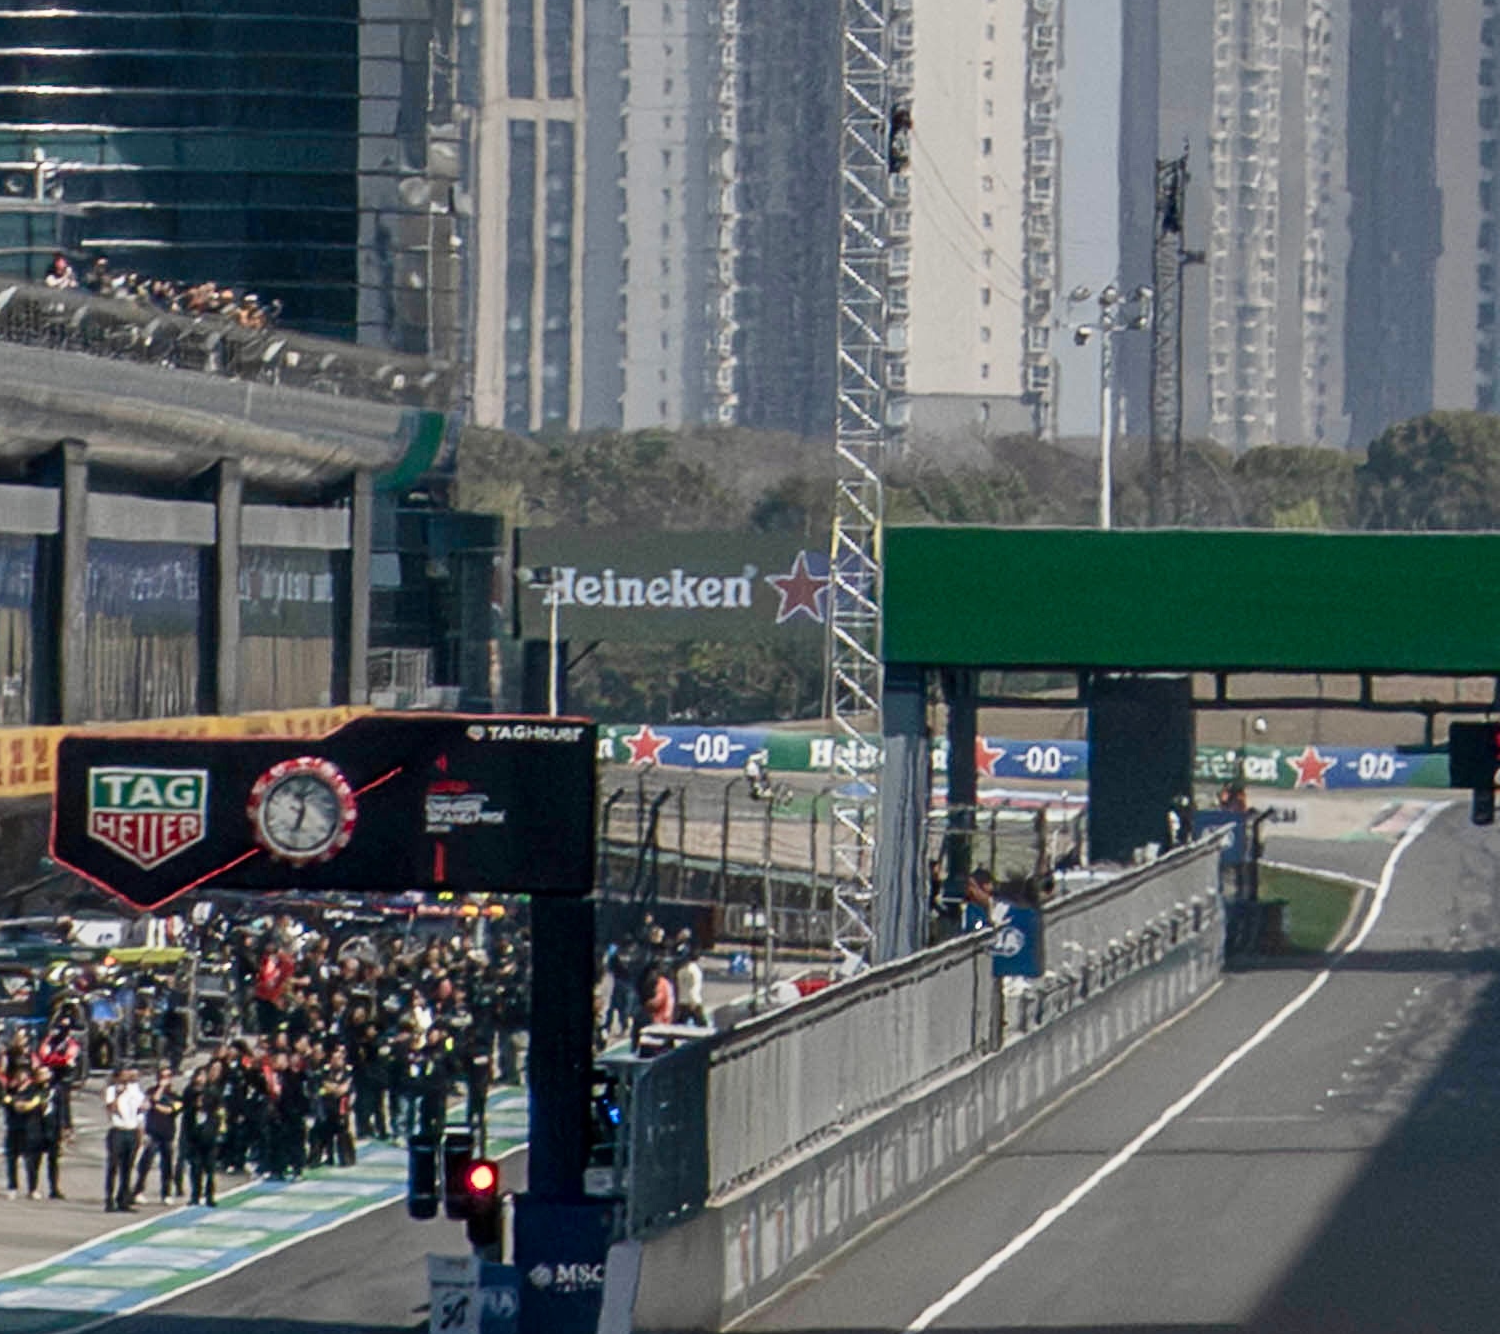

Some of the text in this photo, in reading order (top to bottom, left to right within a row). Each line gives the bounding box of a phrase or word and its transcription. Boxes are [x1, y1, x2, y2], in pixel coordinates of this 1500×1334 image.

[100, 776, 195, 807] TAG
[97, 816, 199, 859] HEUER
[556, 1264, 605, 1283] MSC
